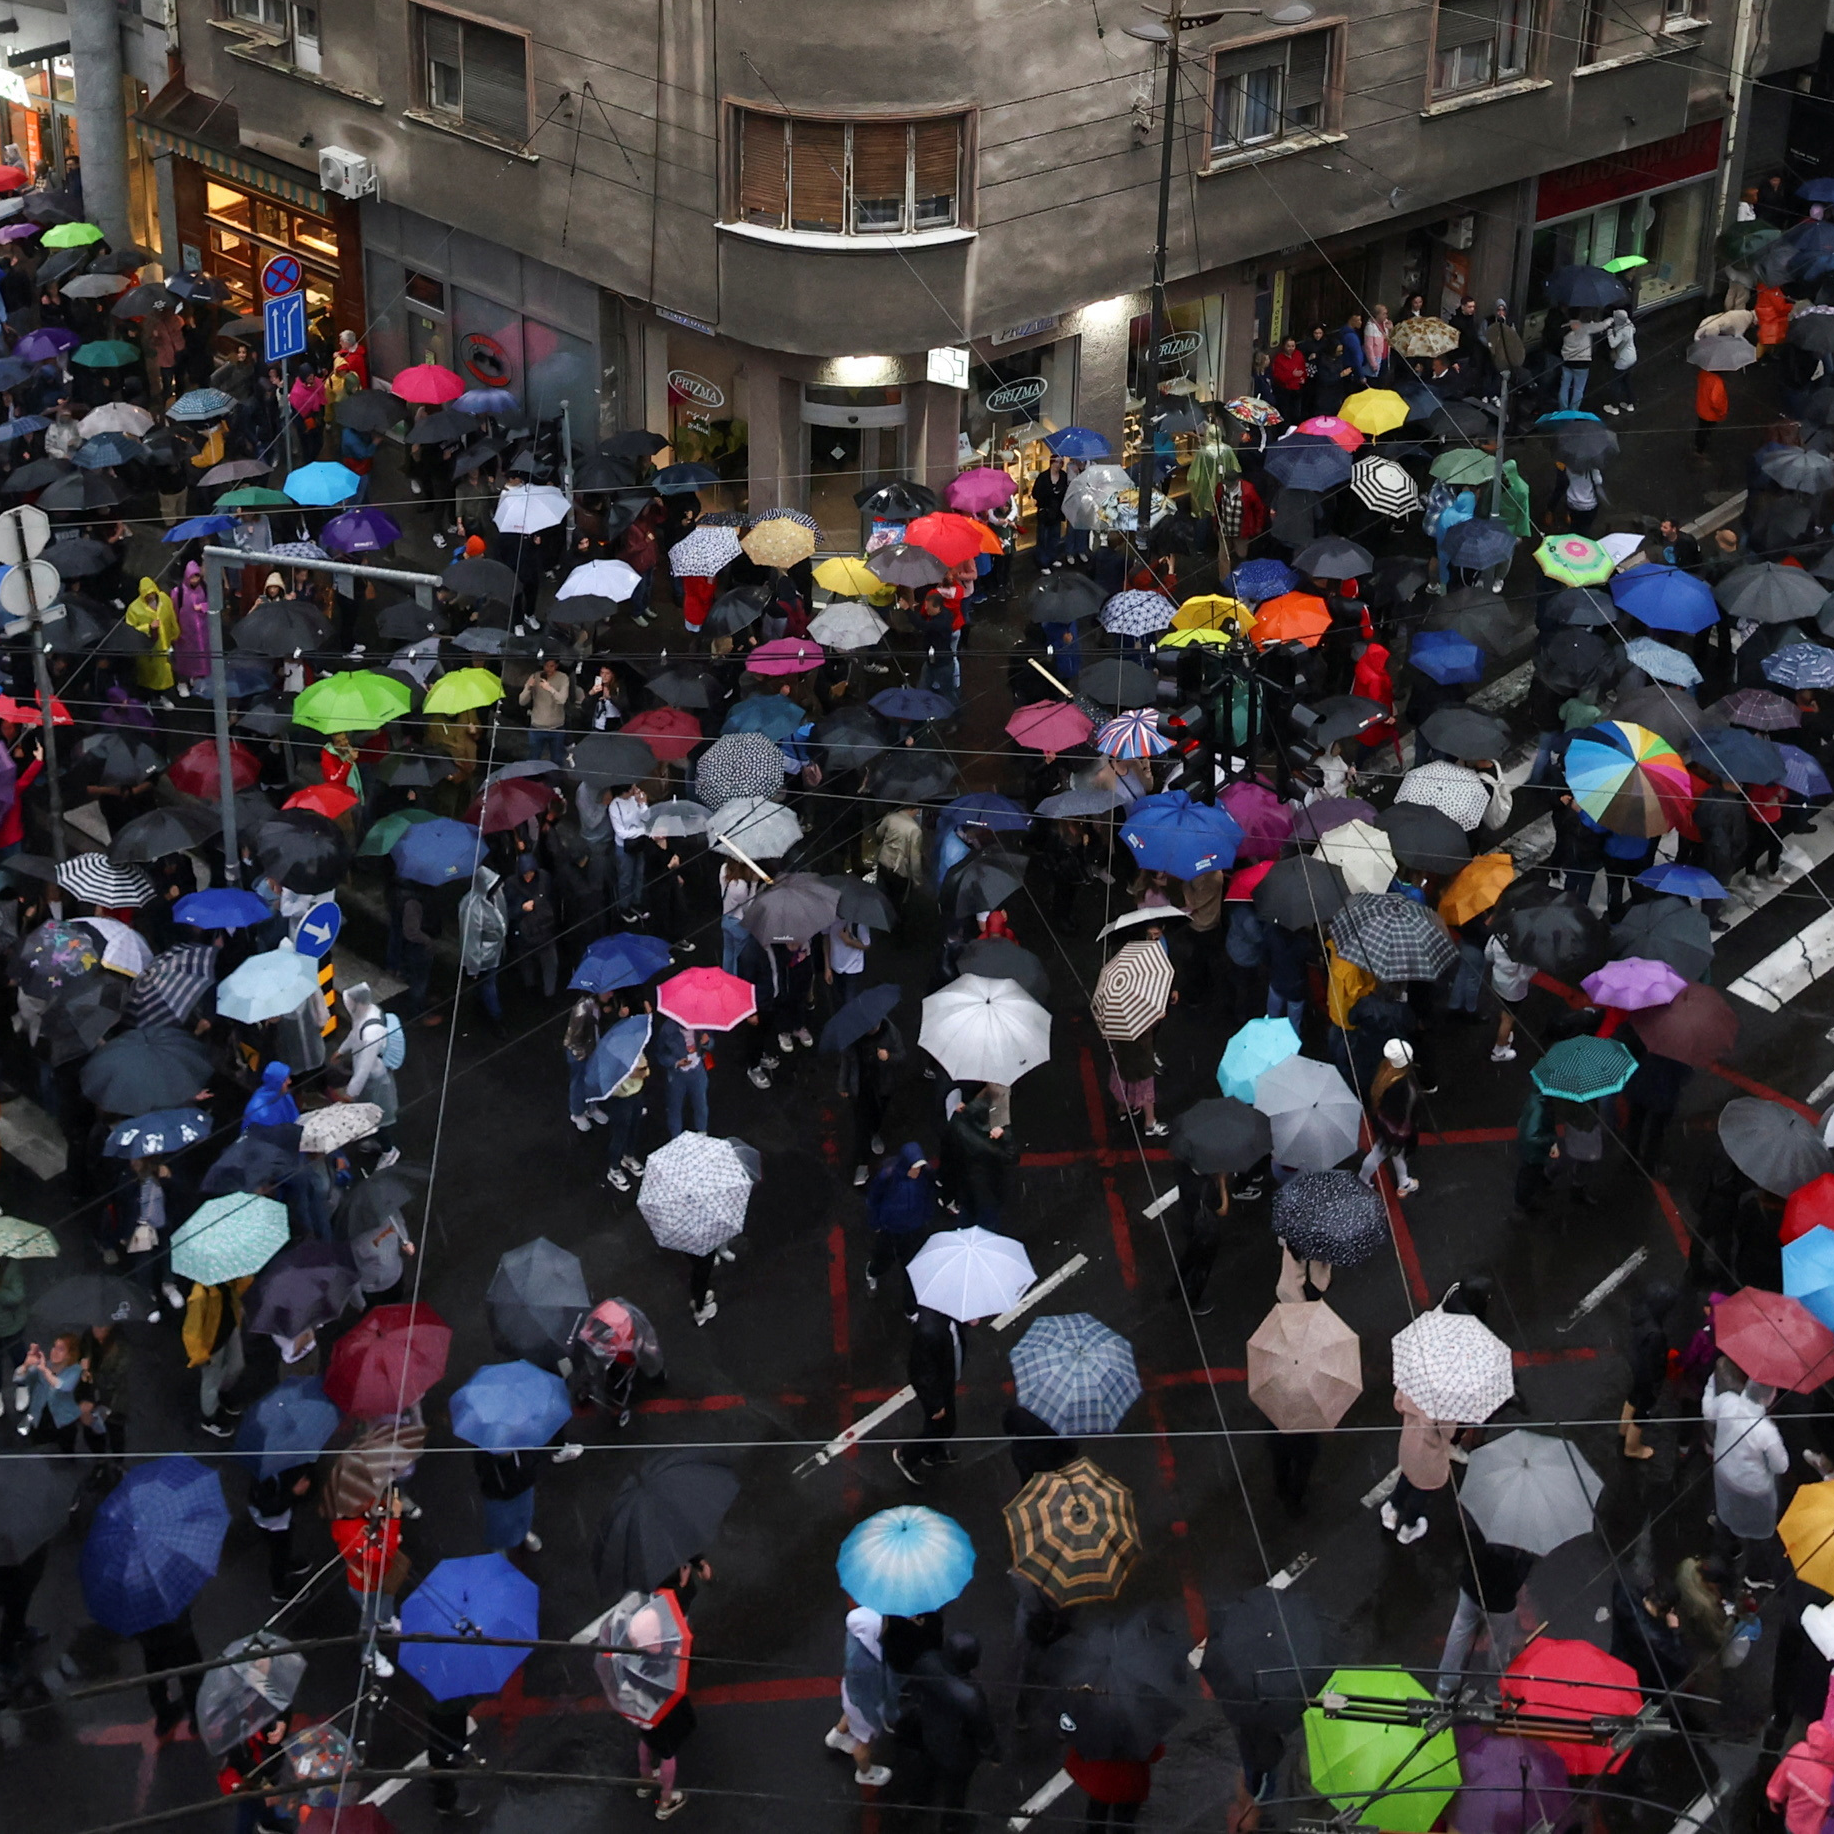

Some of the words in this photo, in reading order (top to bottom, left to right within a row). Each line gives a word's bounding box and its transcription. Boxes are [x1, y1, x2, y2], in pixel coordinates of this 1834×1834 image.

[1158, 337, 1196, 357] RIZMA
[674, 374, 718, 405] PRIZMA
[993, 382, 1041, 407] PRIZMA
